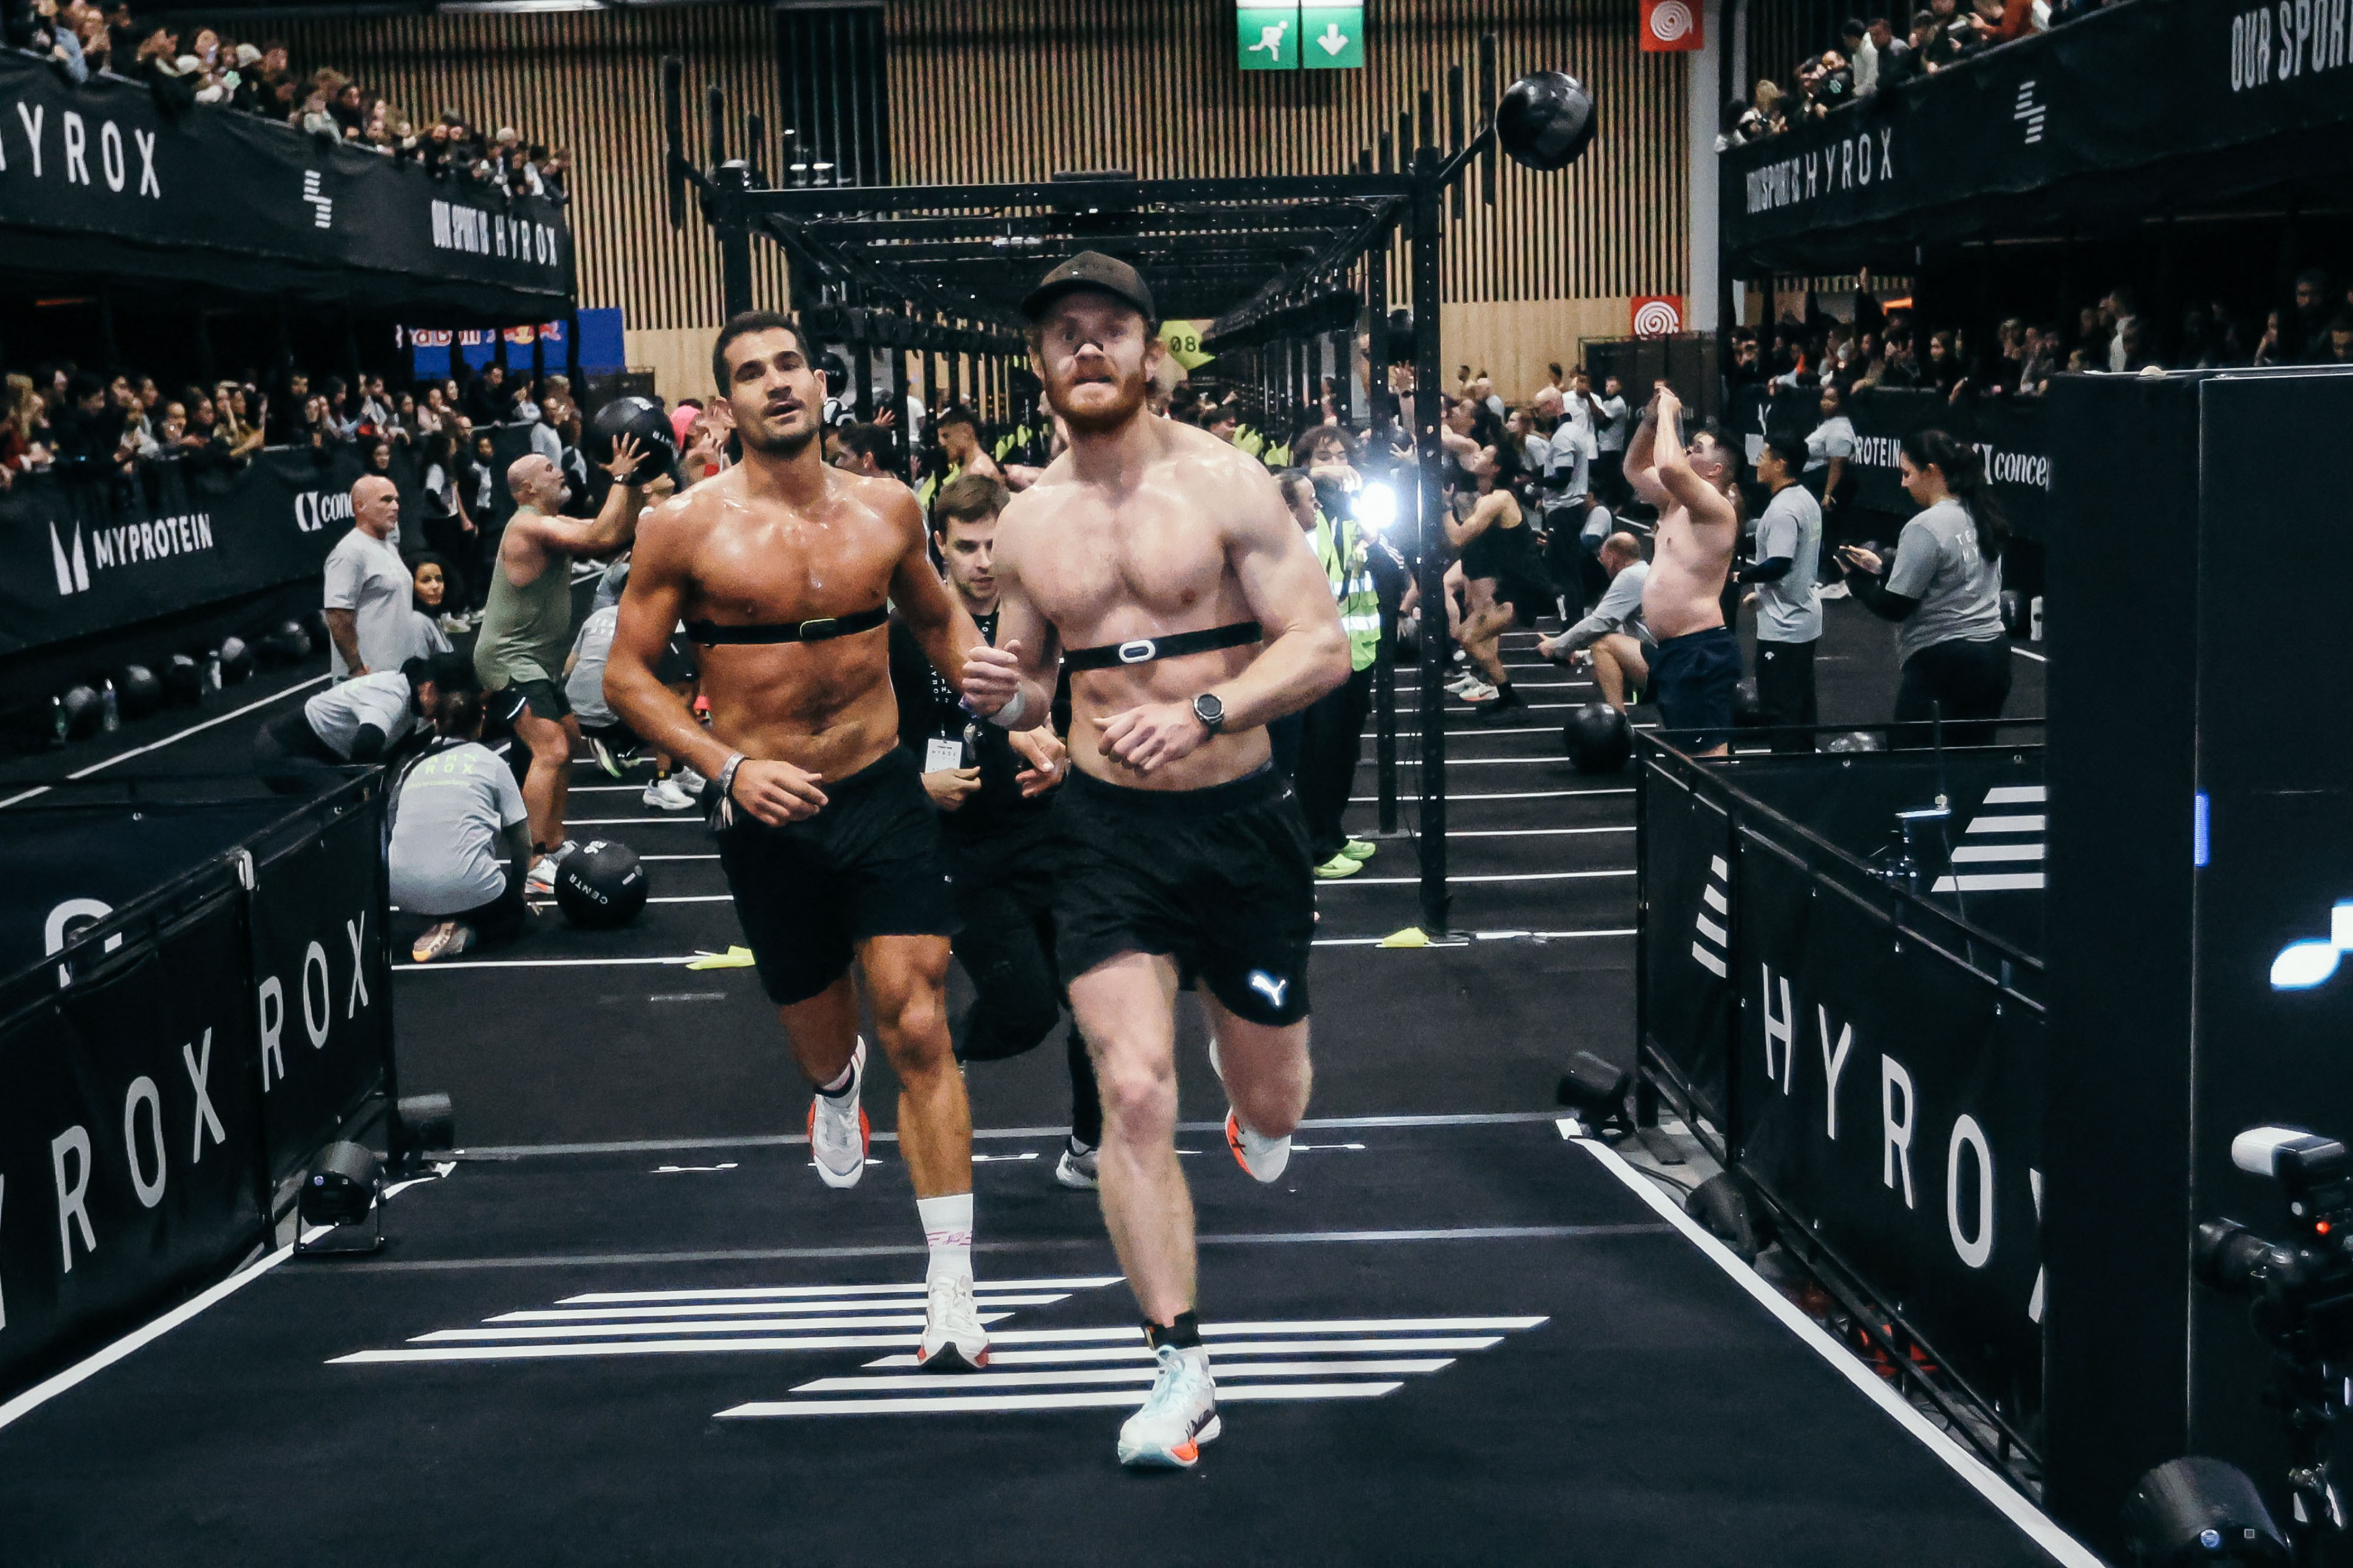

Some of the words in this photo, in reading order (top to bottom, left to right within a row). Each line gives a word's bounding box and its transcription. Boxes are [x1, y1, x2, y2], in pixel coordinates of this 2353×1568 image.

[2231, 15, 2271, 92] OUR
[2278, 0, 2353, 80] SPOR
[0, 101, 160, 199] YROX
[1805, 127, 1892, 199] HYROX
[495, 213, 557, 267] HYROX
[1854, 436, 1901, 468] ROTEIN
[92, 513, 212, 569] MYPROTEIN
[1955, 530, 1972, 545] TE
[569, 873, 608, 904] CENTR
[0, 1027, 225, 1330] ROX
